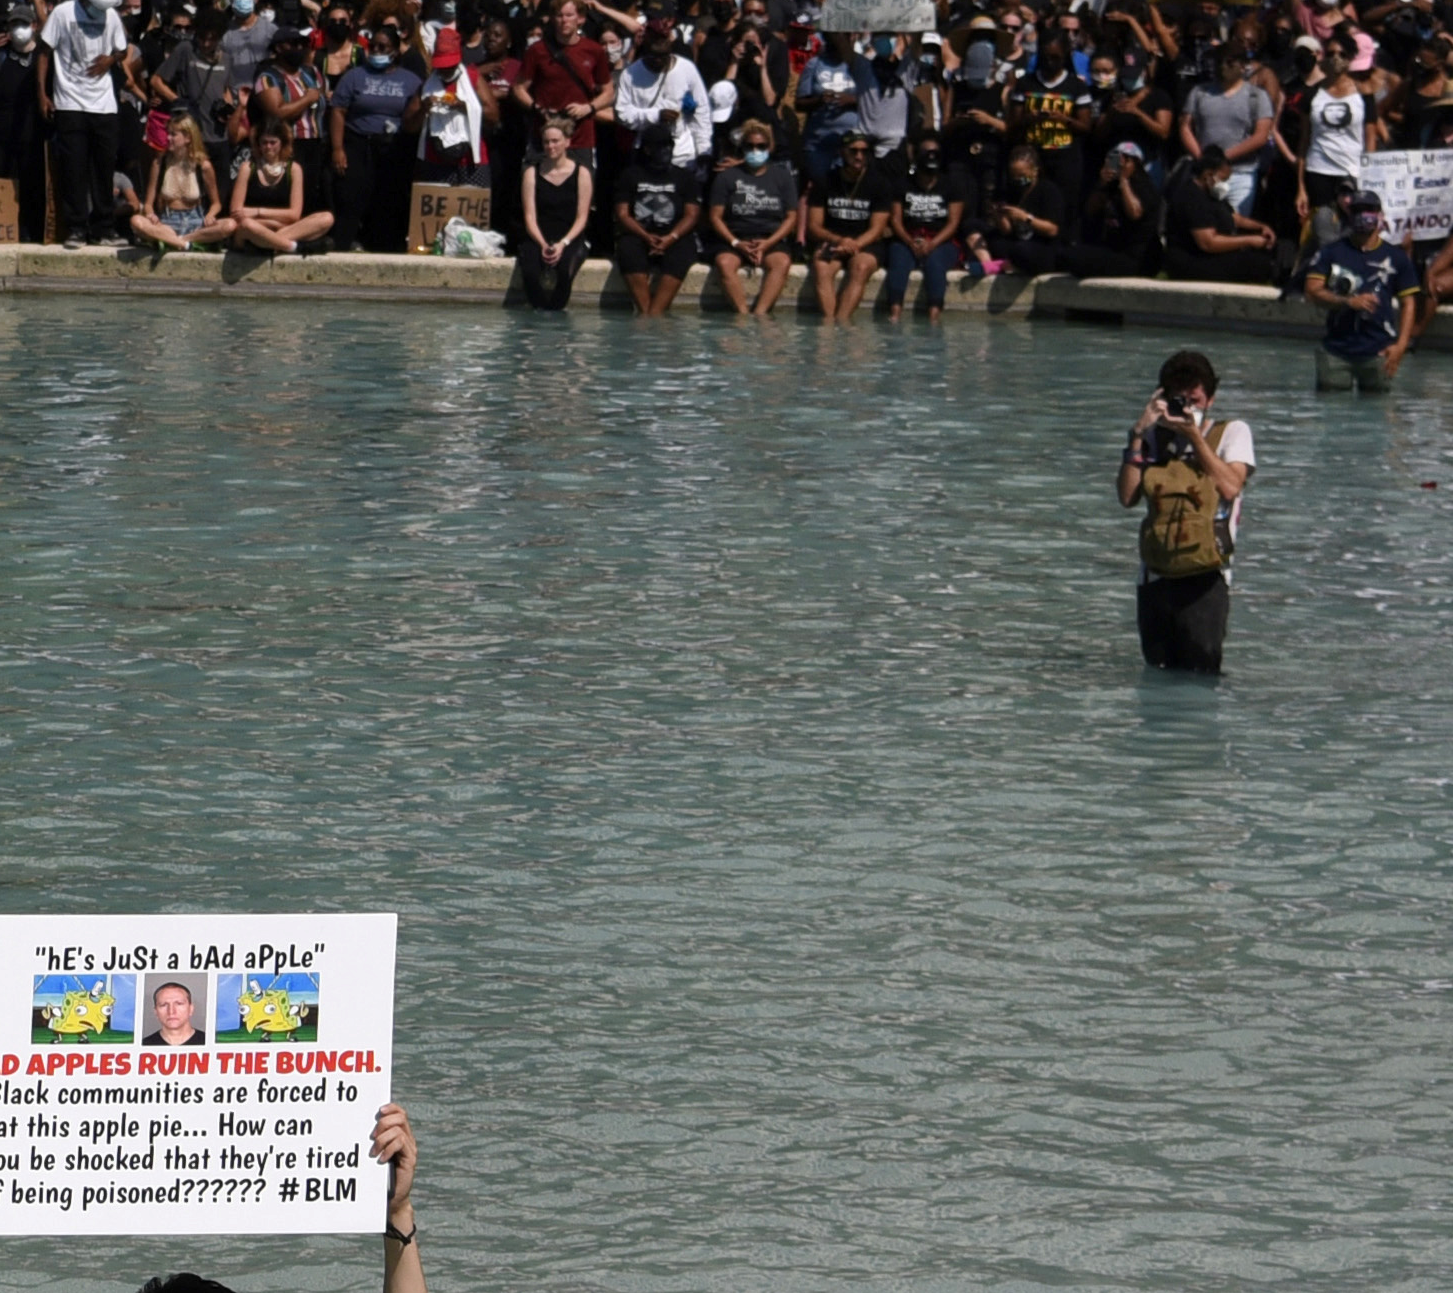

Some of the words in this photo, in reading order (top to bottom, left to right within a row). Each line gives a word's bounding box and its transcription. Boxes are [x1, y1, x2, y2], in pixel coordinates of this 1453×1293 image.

[421, 195, 447, 216] BE
[456, 197, 490, 220] THE
[103, 947, 159, 970] JuSt
[167, 951, 179, 970] a
[189, 944, 235, 970] bAd
[25, 1051, 131, 1076] APPLES
[137, 1051, 210, 1075] RUIN
[216, 1051, 269, 1074] THE
[276, 1050, 382, 1074] BUNCH.
[57, 1079, 204, 1104] communities
[213, 1085, 248, 1104] are
[256, 1077, 327, 1103] forced
[336, 1080, 358, 1102] to
[26, 1114, 69, 1137] this
[78, 1113, 140, 1145] apple
[149, 1115, 208, 1144] pie...
[218, 1113, 266, 1136] How
[274, 1117, 313, 1136] can
[30, 1146, 56, 1172] be
[65, 1145, 154, 1171] shocked
[163, 1146, 211, 1170] that
[219, 1145, 297, 1176] they're
[306, 1143, 360, 1169] tired
[11, 1179, 72, 1211] being
[83, 1179, 266, 1210] poisoned??????
